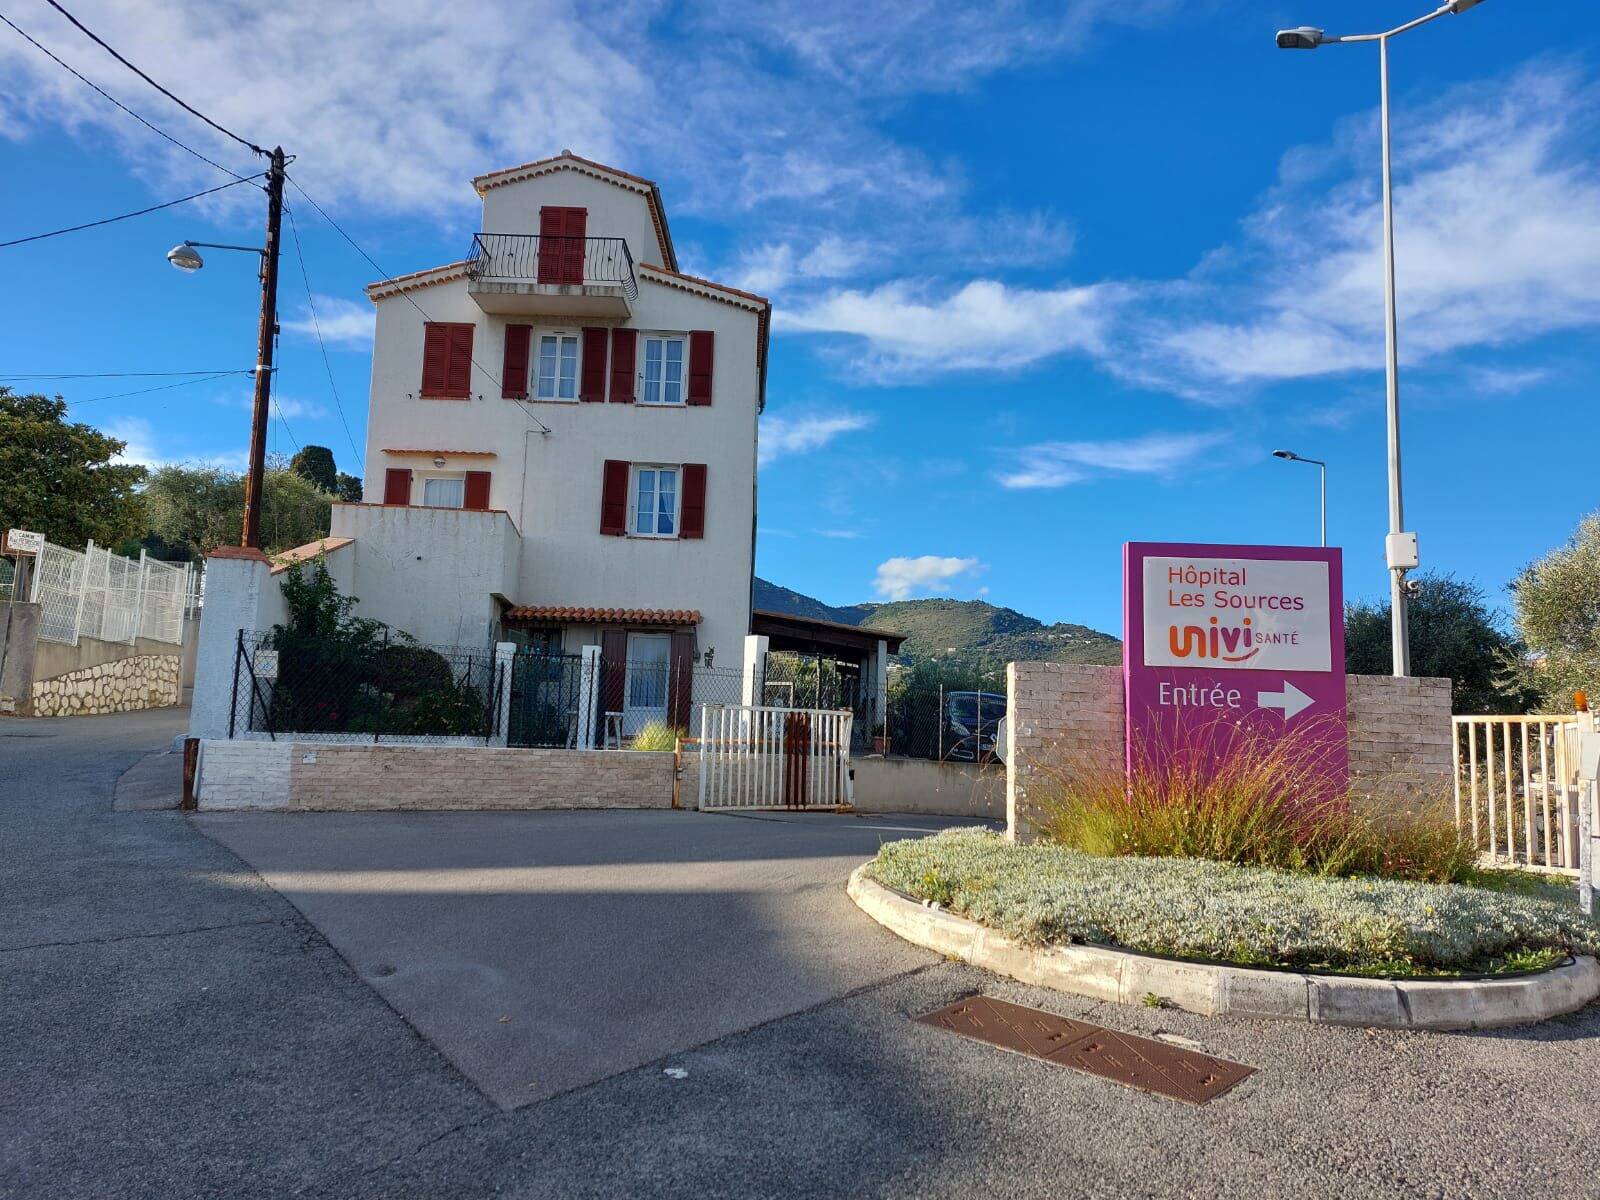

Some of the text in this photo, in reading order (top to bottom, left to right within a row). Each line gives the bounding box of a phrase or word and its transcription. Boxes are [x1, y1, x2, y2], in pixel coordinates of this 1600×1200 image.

[1168, 565, 1246, 587] Hôpital
[1168, 589, 1304, 611] Les Sources
[1169, 616, 1299, 659] univi SANTÉ
[1159, 682, 1241, 709] Entrée
